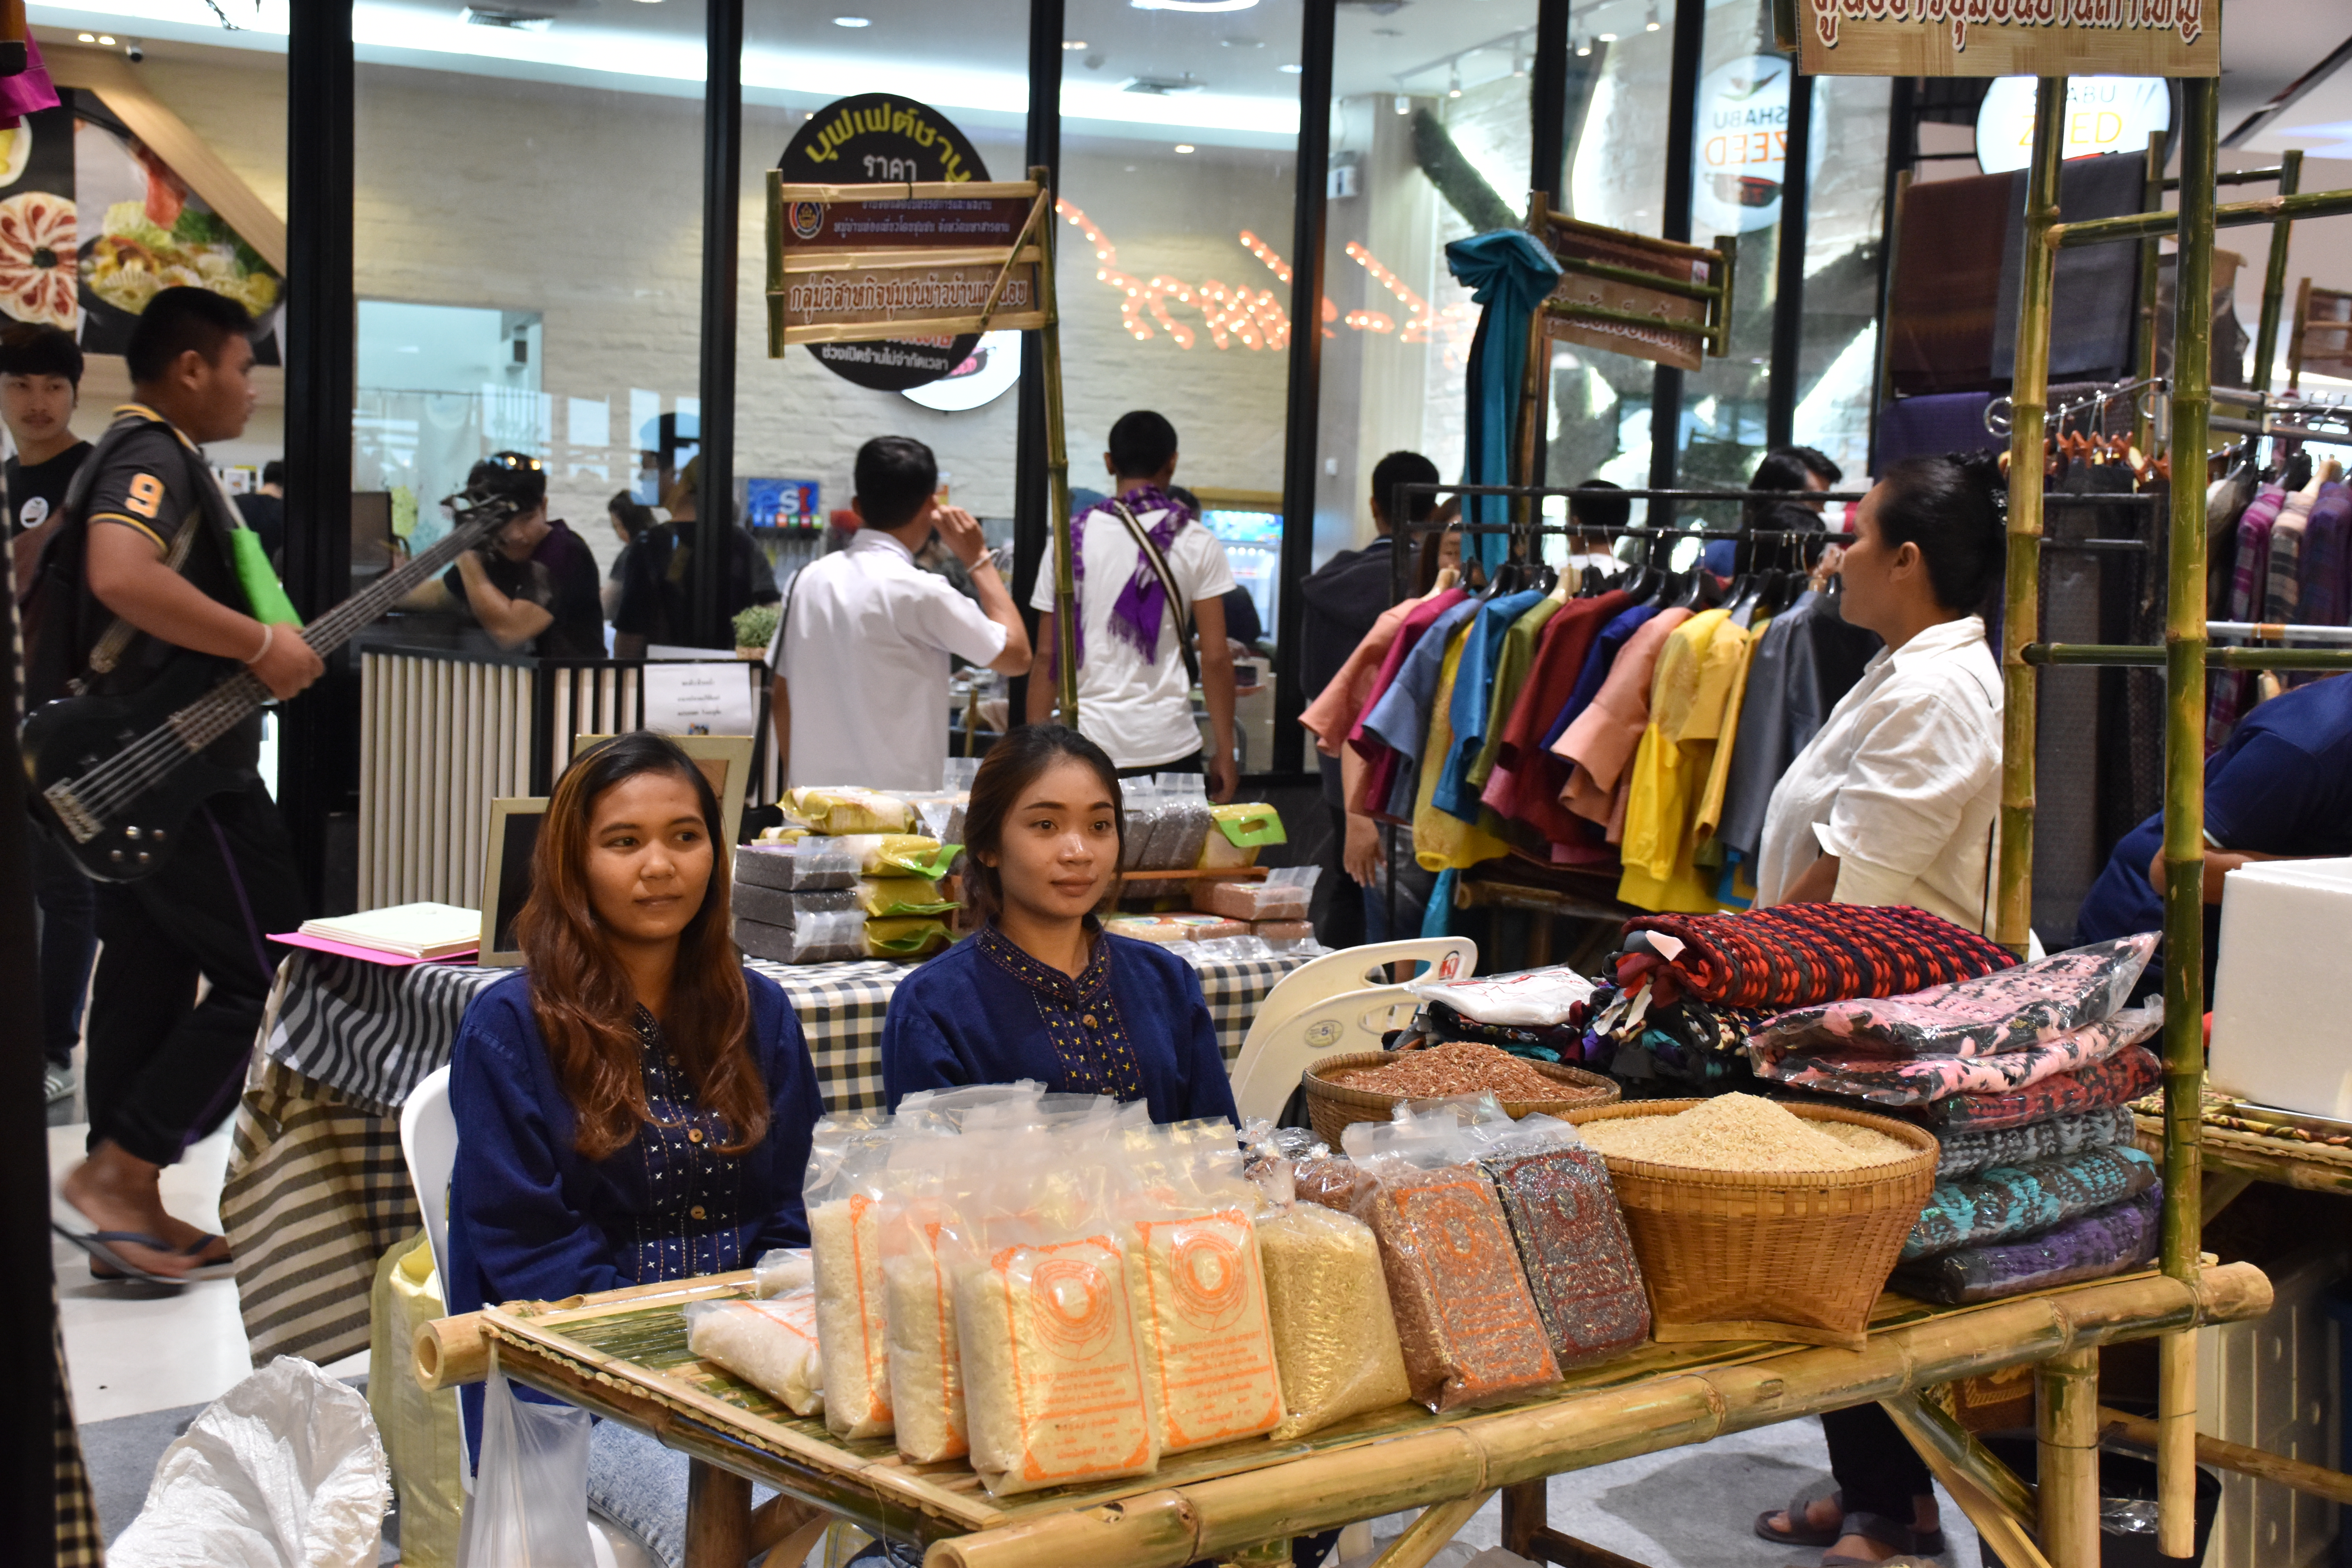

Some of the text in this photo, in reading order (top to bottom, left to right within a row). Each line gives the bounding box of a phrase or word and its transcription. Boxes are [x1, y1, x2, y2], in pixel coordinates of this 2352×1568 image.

[2033, 85, 2116, 103] ABU
[2018, 111, 2122, 146] ZED
[124, 472, 165, 519] 9
